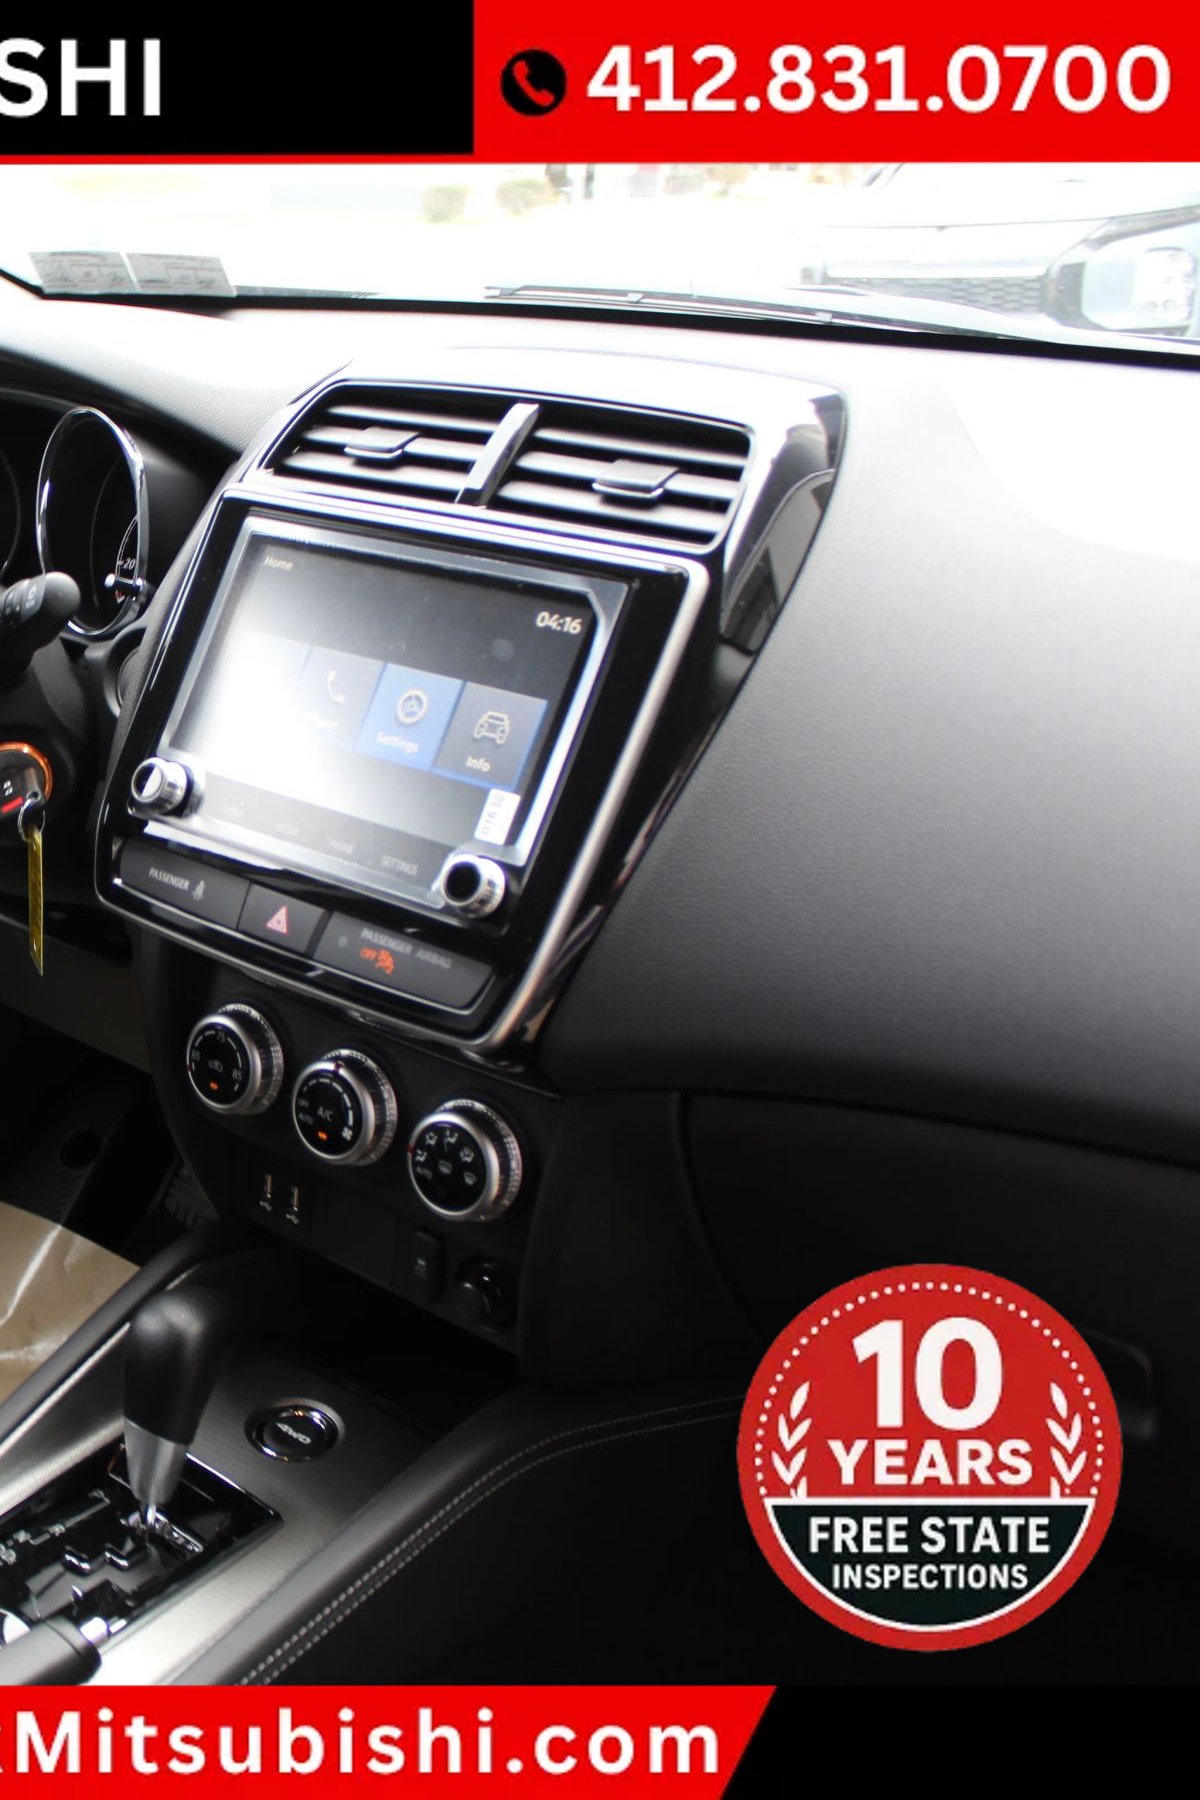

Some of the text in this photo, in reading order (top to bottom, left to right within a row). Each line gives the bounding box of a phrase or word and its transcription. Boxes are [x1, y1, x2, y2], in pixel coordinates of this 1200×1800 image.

[122, 557, 136, 570] 20
[263, 555, 294, 571] Home
[536, 611, 582, 635] 04:16
[376, 730, 420, 755] Settings
[466, 755, 491, 773] Info
[382, 855, 419, 877] SETTINGS
[148, 866, 191, 893] PASSENGER
[360, 927, 453, 970] PASSENGER AIRBAG
[317, 1106, 334, 1123] A/C
